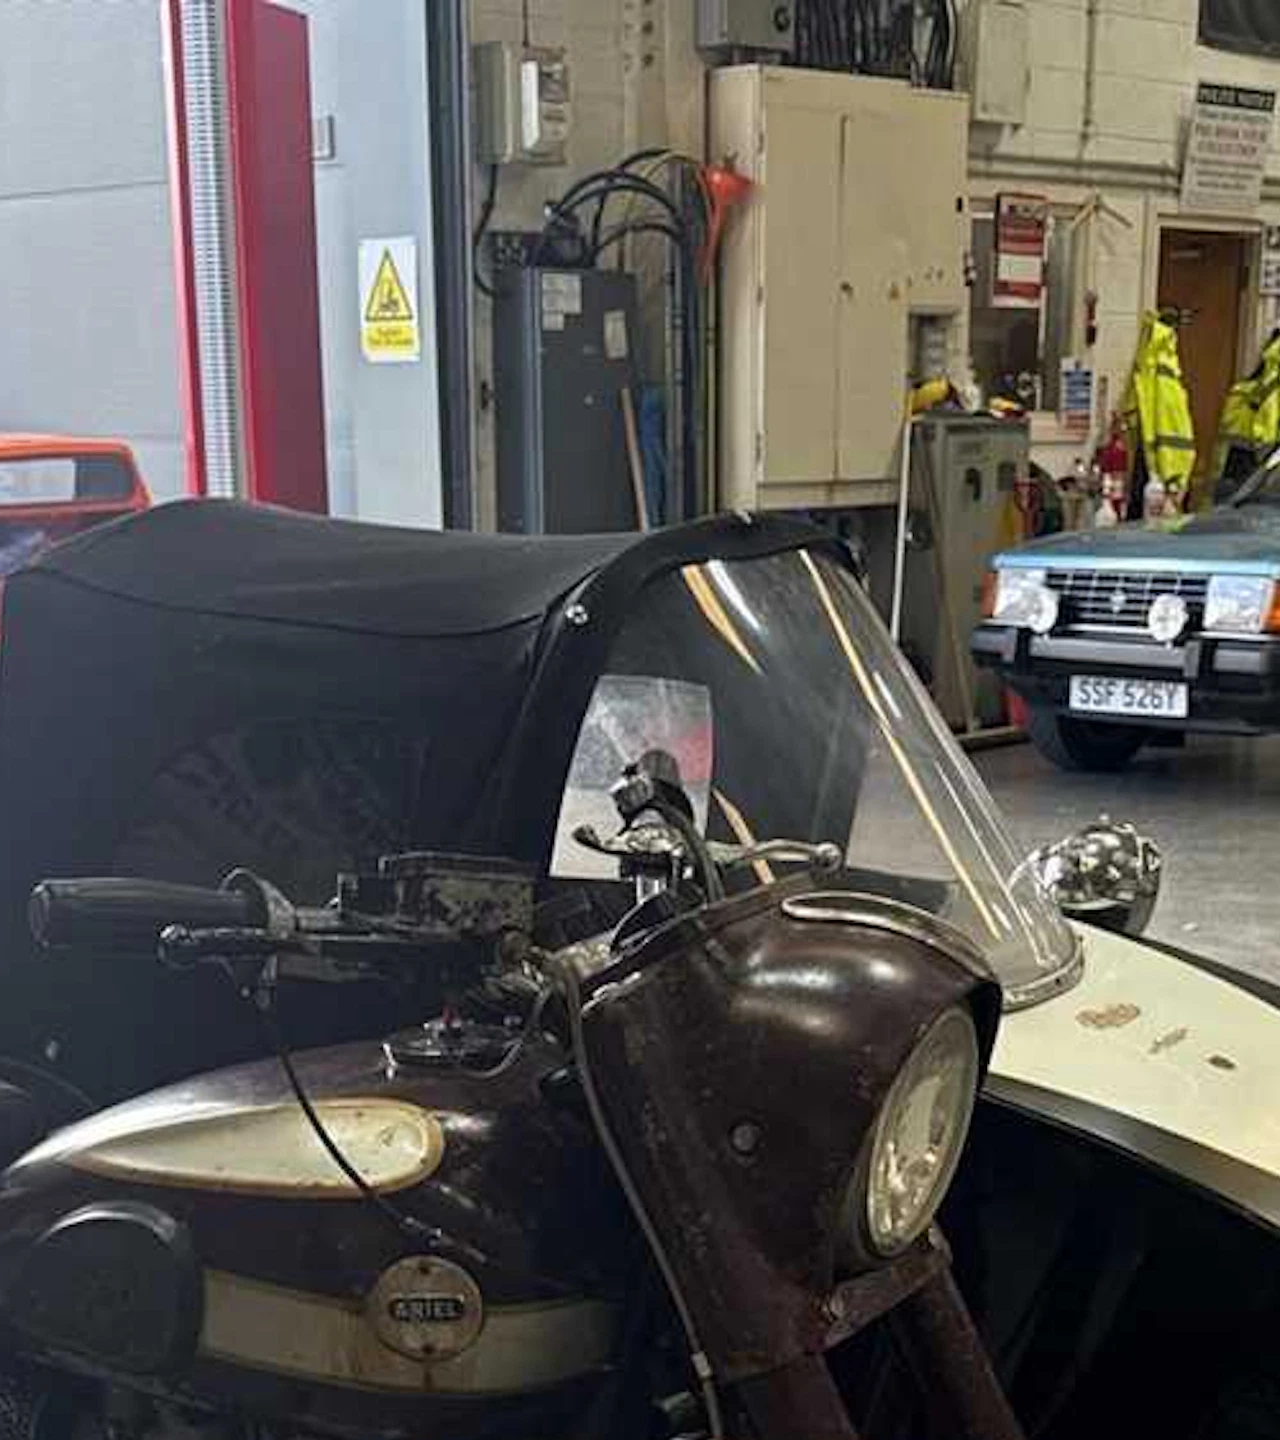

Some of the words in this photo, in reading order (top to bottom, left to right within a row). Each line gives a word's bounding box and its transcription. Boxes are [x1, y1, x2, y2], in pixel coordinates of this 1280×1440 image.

[1078, 680, 1116, 706] SSF
[1124, 681, 1178, 710] 526Y
[394, 1299, 458, 1320] ARIEL
